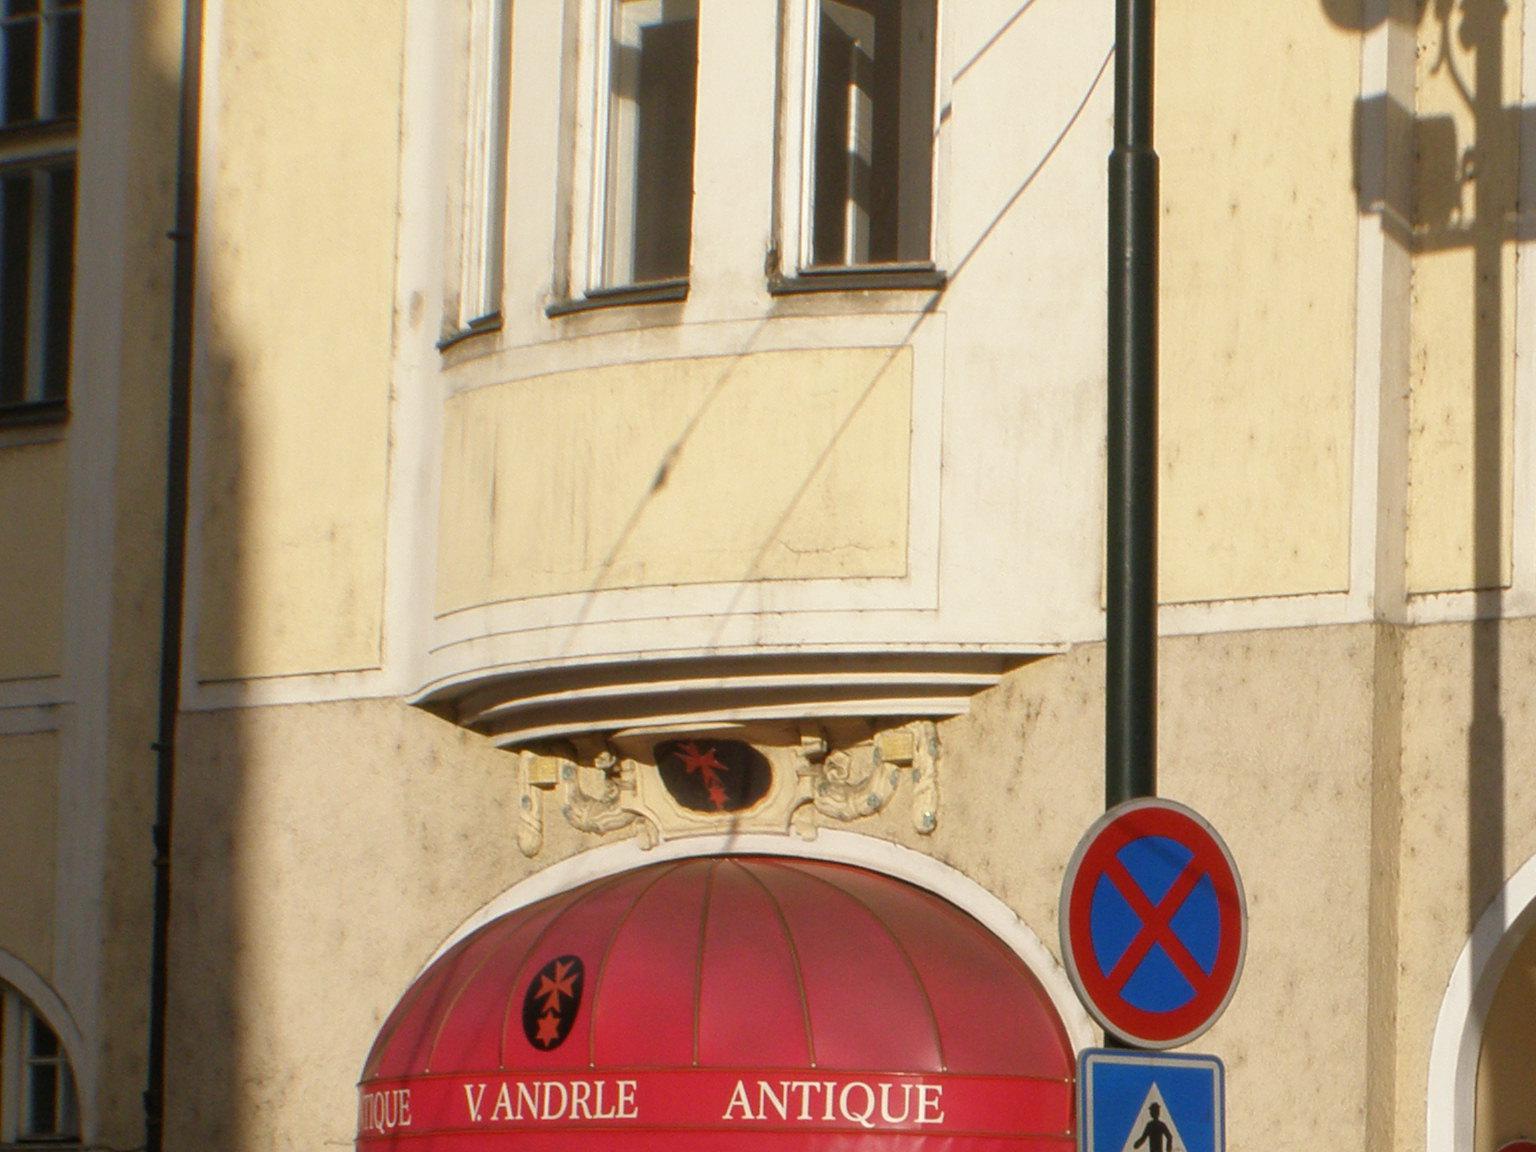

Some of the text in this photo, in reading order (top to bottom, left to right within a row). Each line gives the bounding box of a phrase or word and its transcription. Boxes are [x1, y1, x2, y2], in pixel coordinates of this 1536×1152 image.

[363, 1088, 412, 1134] TIQUE
[490, 1080, 639, 1120] ANDRLE
[722, 1080, 945, 1128] ANTIQUE
